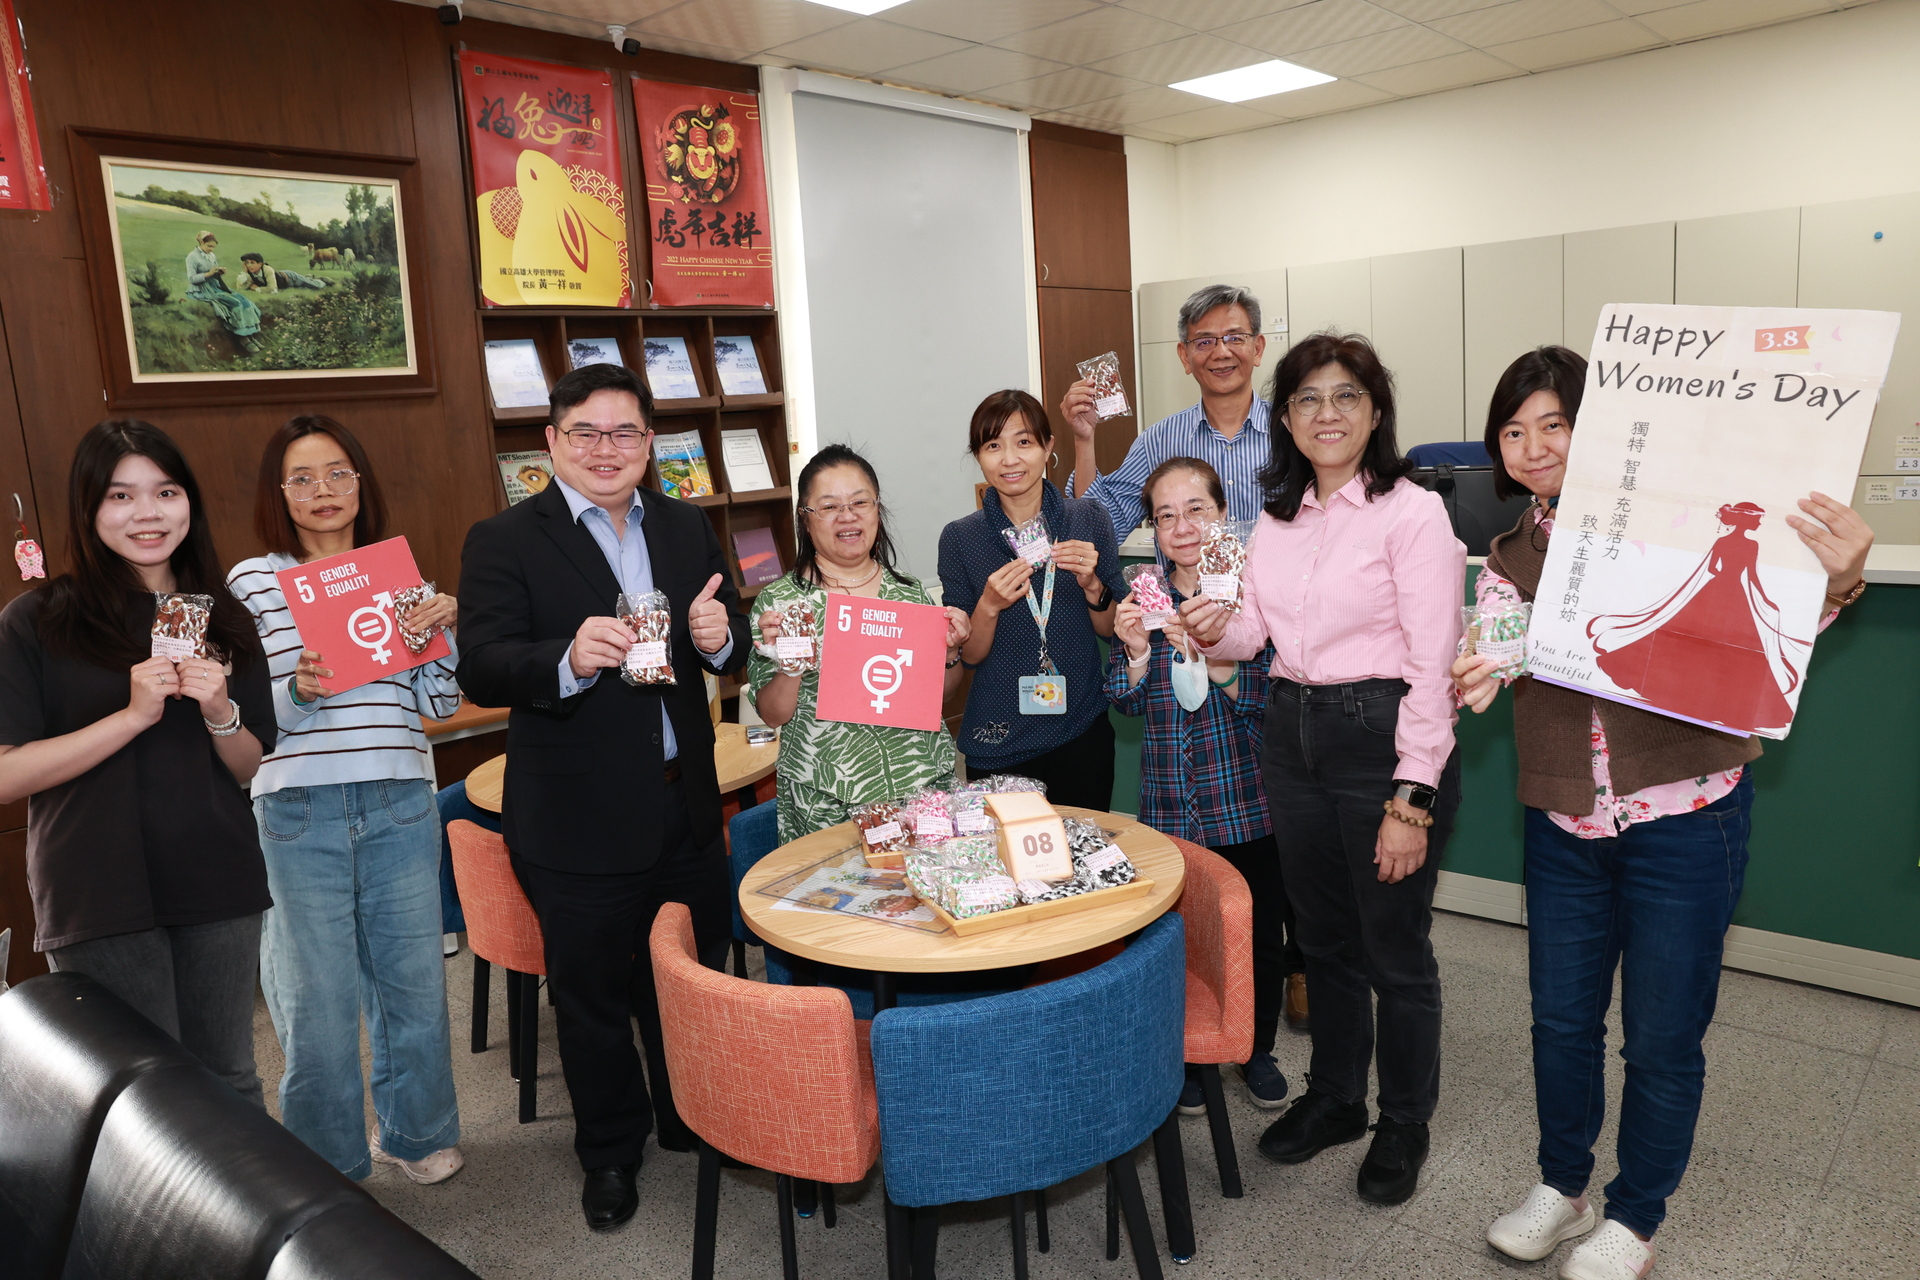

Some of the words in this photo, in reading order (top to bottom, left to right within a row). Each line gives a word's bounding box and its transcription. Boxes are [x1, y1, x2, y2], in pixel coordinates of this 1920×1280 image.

[477, 87, 600, 145] 福兔迎祥
[569, 130, 596, 149] 2023
[654, 207, 762, 249] 虎年吉祥
[666, 255, 679, 263] 2022
[1605, 314, 1726, 360] Happy
[1761, 330, 1799, 350] 3.8
[1597, 360, 1757, 401] Women's
[1774, 373, 1861, 421] Day
[1627, 421, 1649, 453] 獨特
[498, 454, 512, 462] MIT
[511, 453, 531, 461] Sloan
[1899, 460, 1909, 468] 上
[1912, 459, 1919, 468] 3
[1619, 458, 1640, 491] 智慧
[1898, 489, 1909, 498] 下
[1911, 488, 1918, 498] 3
[1602, 497, 1632, 560] 充滿活力
[293, 575, 316, 604] 5
[319, 562, 359, 583] GENDER
[324, 573, 370, 598] EQUALITY
[837, 604, 852, 632] 5
[862, 608, 897, 624] GENDER
[860, 622, 903, 639] EQUALITY
[1533, 639, 1556, 655] You
[1561, 649, 1587, 662] Are
[1529, 655, 1592, 681] Beautiful
[1022, 832, 1054, 857] 08
